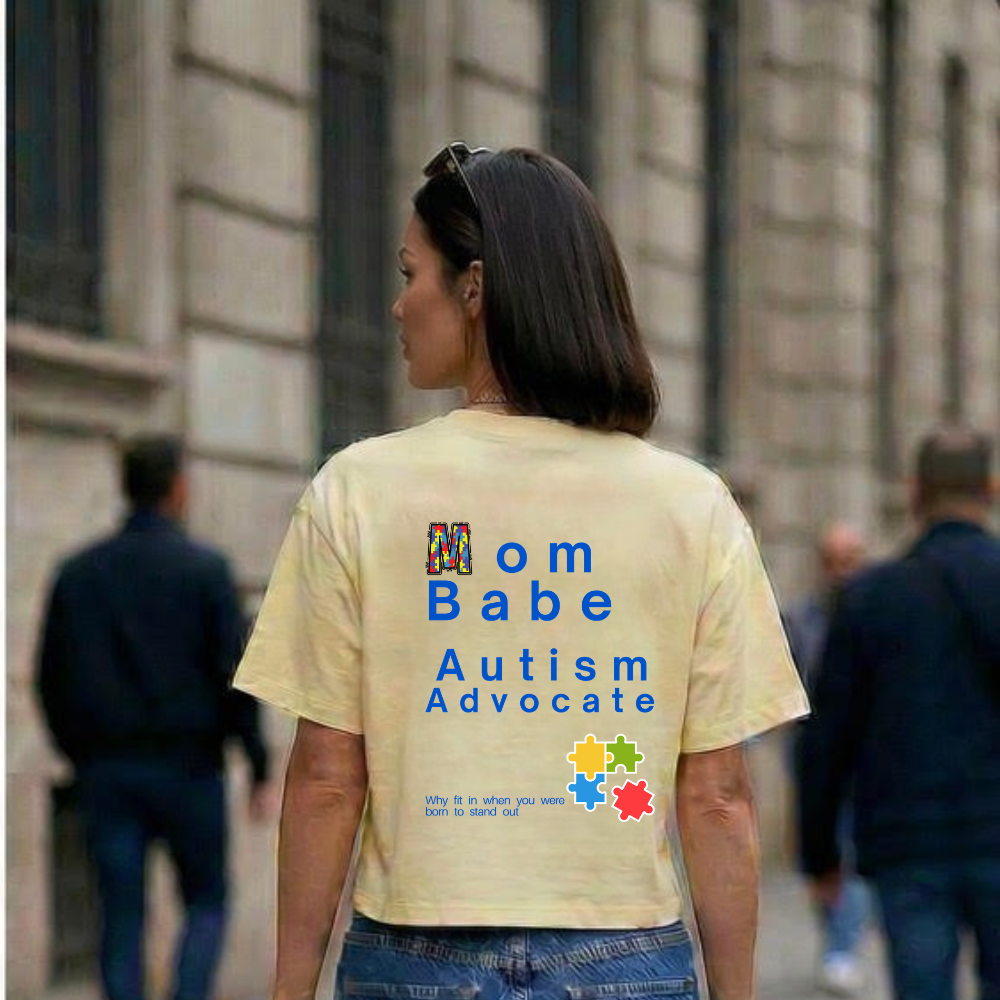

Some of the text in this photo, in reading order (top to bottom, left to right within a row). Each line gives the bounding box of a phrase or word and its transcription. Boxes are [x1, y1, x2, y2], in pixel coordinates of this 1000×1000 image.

[426, 522, 592, 575] Mom
[428, 580, 612, 621] Babe
[436, 648, 647, 681] Autism
[425, 687, 655, 713] Advocate
[425, 795, 565, 807] Why fit in when you were
[454, 808, 464, 817] to
[469, 807, 497, 817] stand
[502, 808, 520, 817] out
